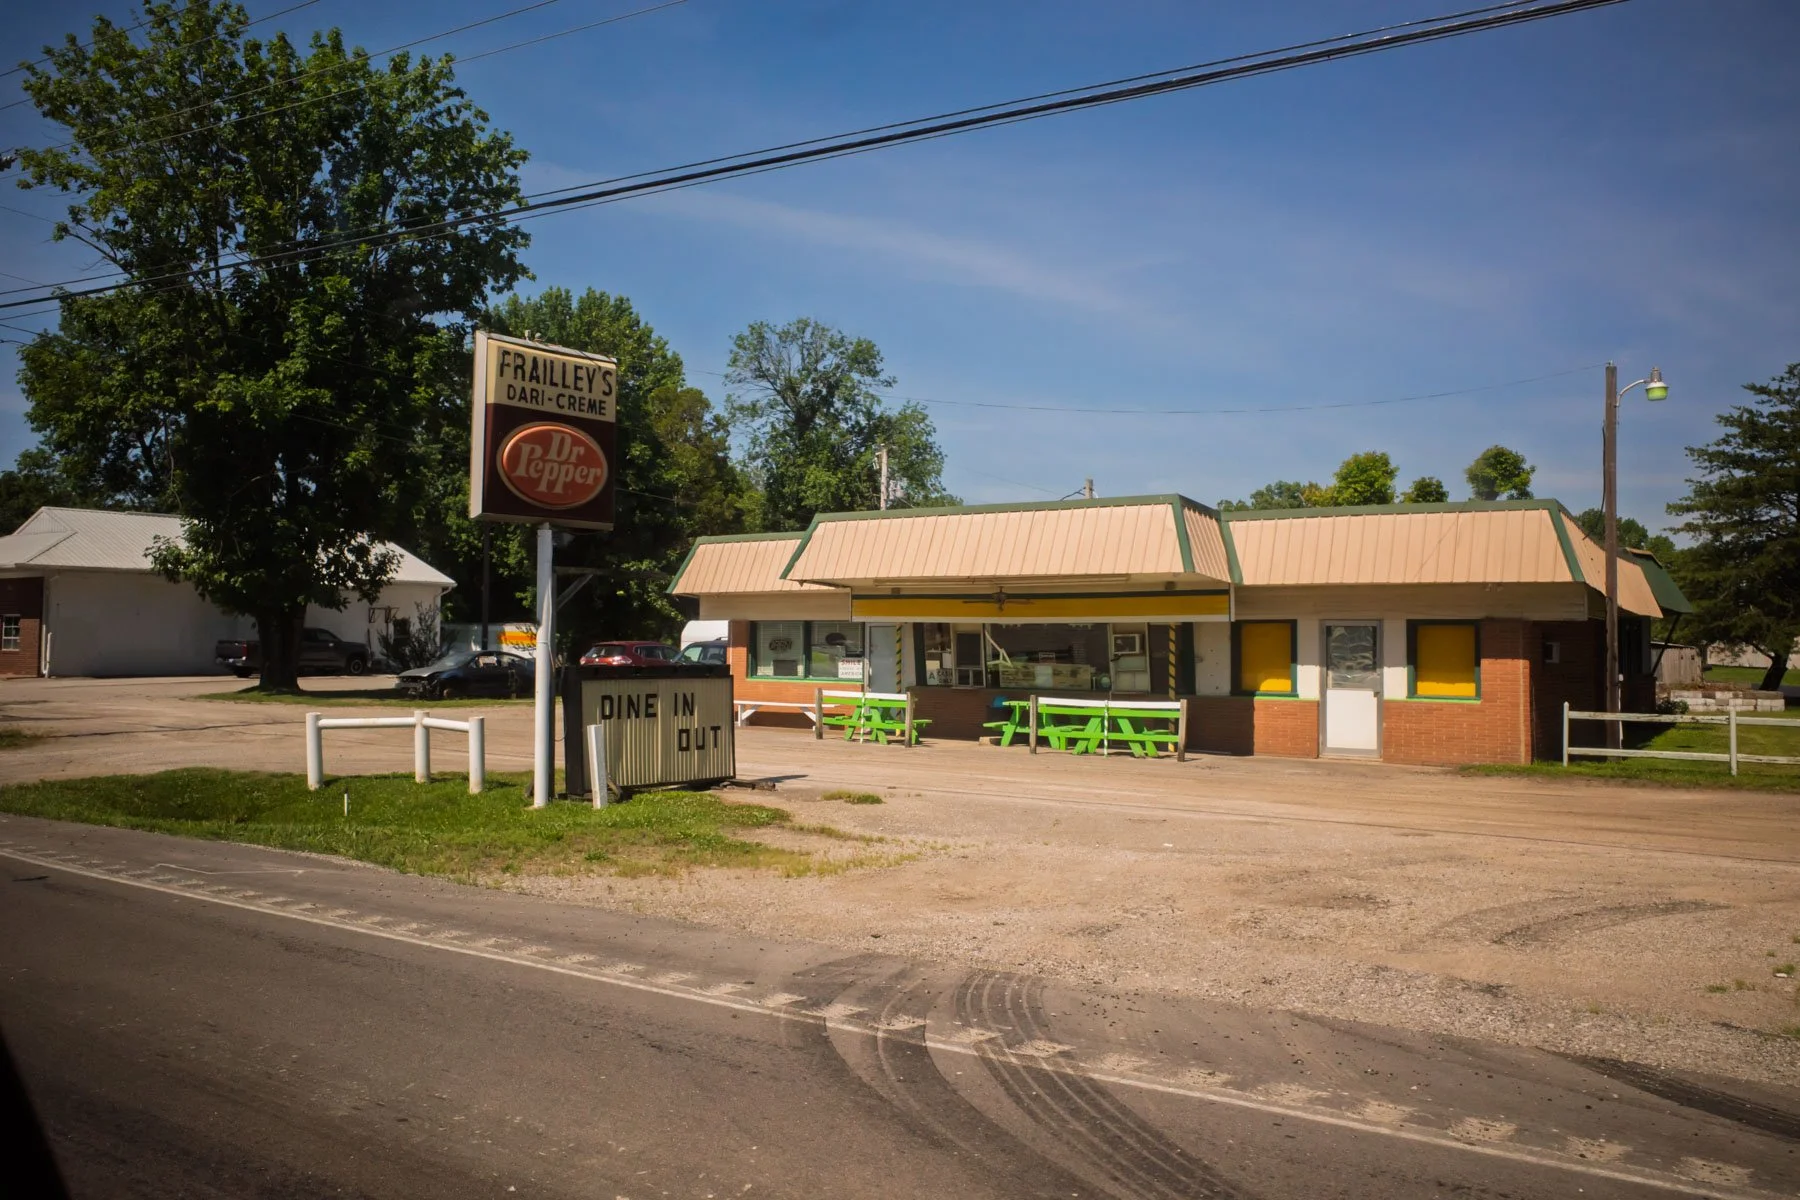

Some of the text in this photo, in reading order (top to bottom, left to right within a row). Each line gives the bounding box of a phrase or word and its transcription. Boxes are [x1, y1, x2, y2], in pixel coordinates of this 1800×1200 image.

[500, 351, 613, 396] FRAILLEY'S
[507, 384, 607, 416] DARI-CREME
[545, 431, 585, 463] Dr
[511, 442, 601, 494] Pepper
[601, 692, 694, 720] DINE IN
[678, 726, 721, 751] OUT
